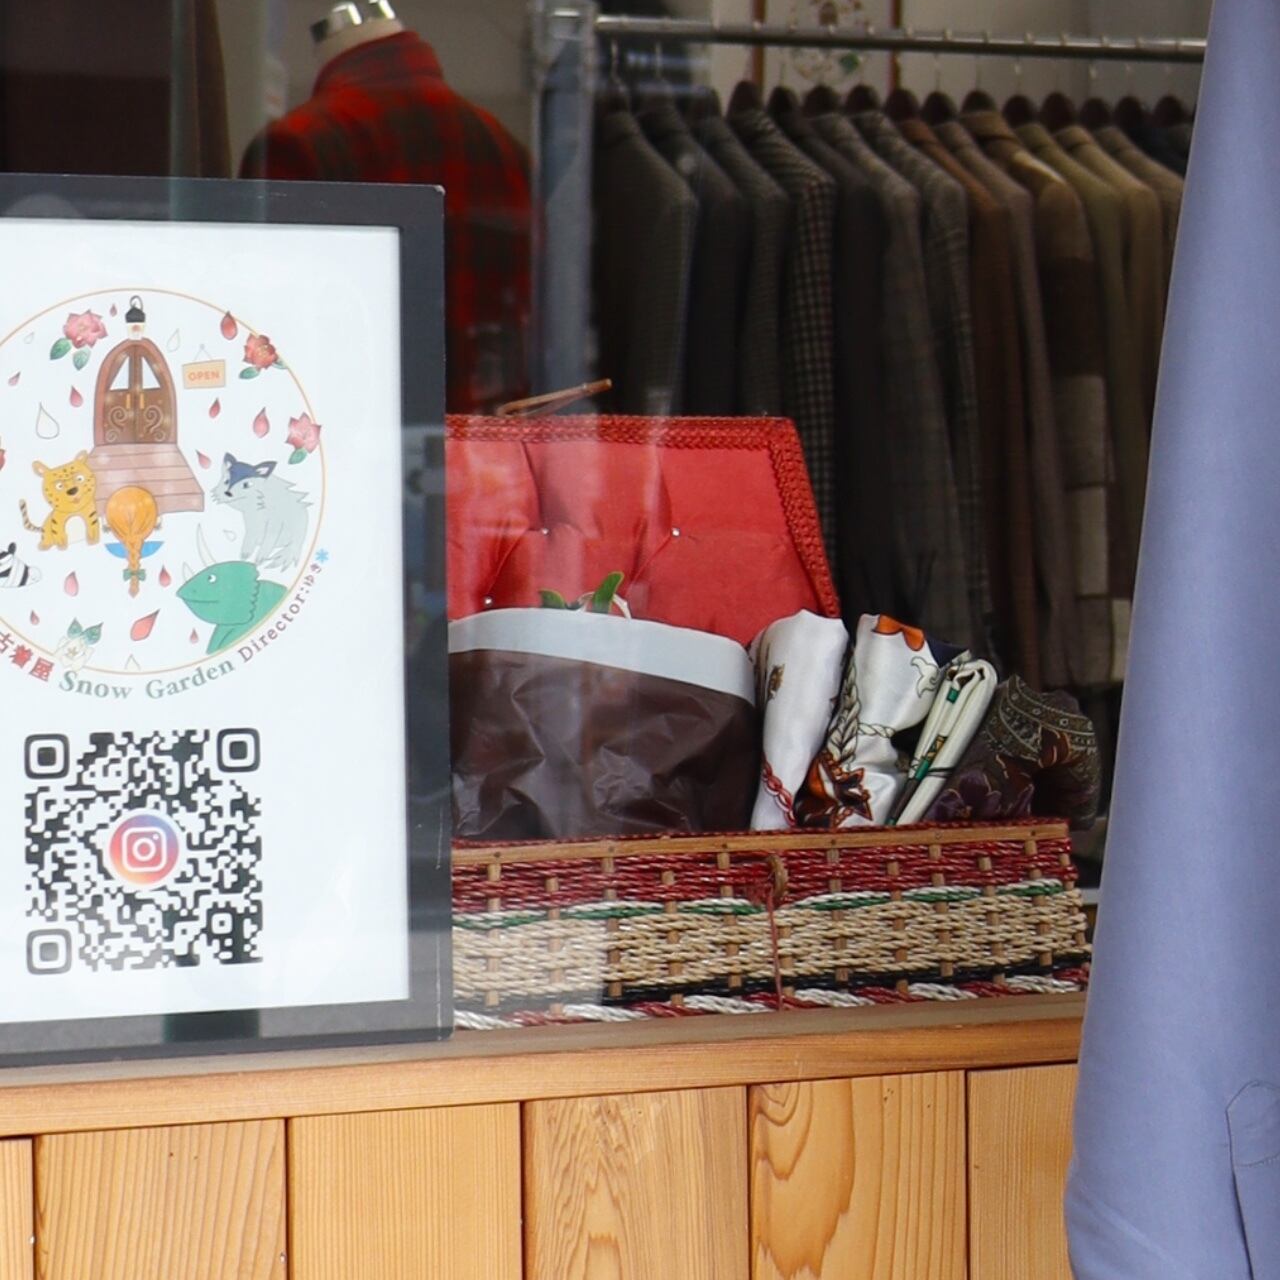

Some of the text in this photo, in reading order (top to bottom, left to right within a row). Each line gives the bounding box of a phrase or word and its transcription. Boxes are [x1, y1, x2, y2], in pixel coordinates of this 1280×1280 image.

[187, 370, 221, 382] OPEN
[58, 669, 133, 700] Snow
[145, 657, 236, 700] Garden
